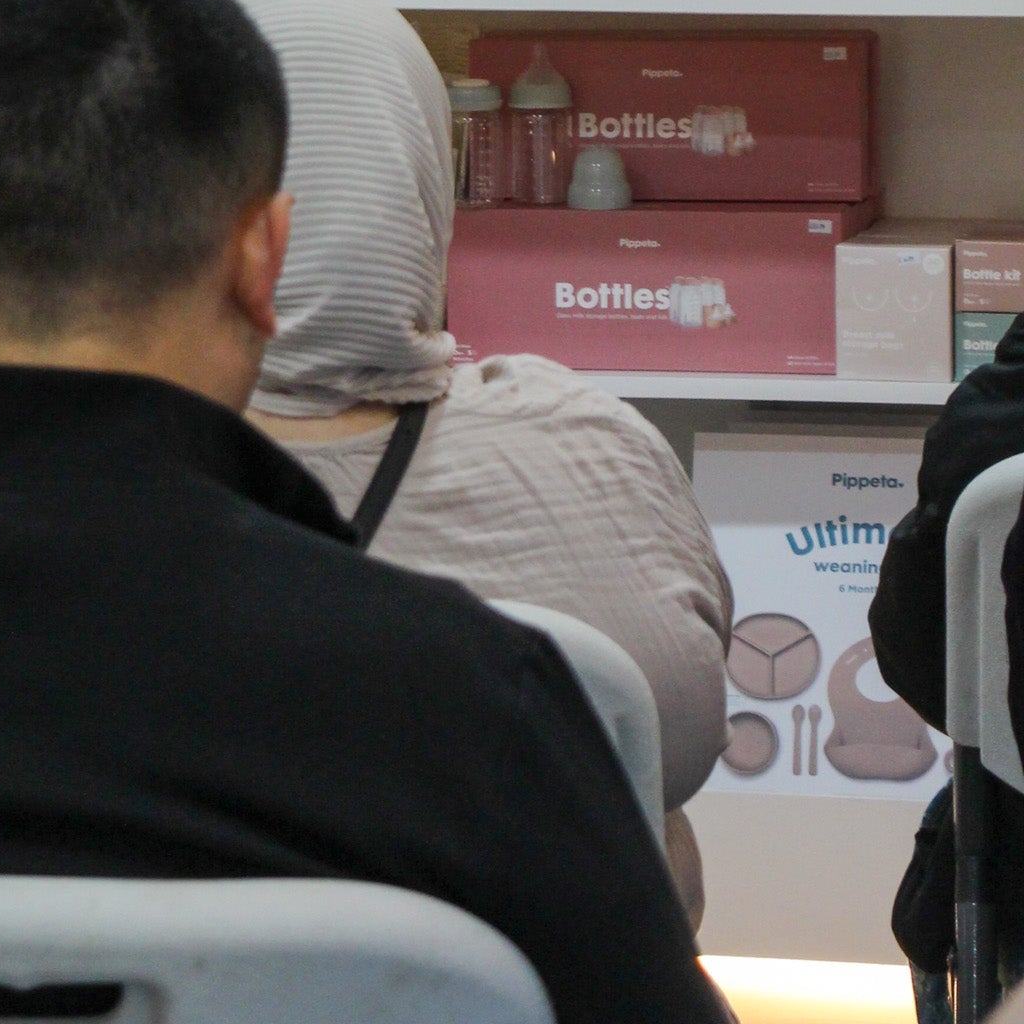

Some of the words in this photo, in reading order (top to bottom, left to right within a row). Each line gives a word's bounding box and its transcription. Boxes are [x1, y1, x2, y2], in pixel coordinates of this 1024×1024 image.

[578, 112, 693, 139] Bottles
[962, 268, 1002, 281] Bottle
[1004, 269, 1022, 281] kit
[555, 282, 672, 310] Bottles
[785, 514, 887, 556] Ultim
[814, 560, 880, 574] weanin
[838, 584, 846, 593] 6
[848, 584, 878, 594] Mont
